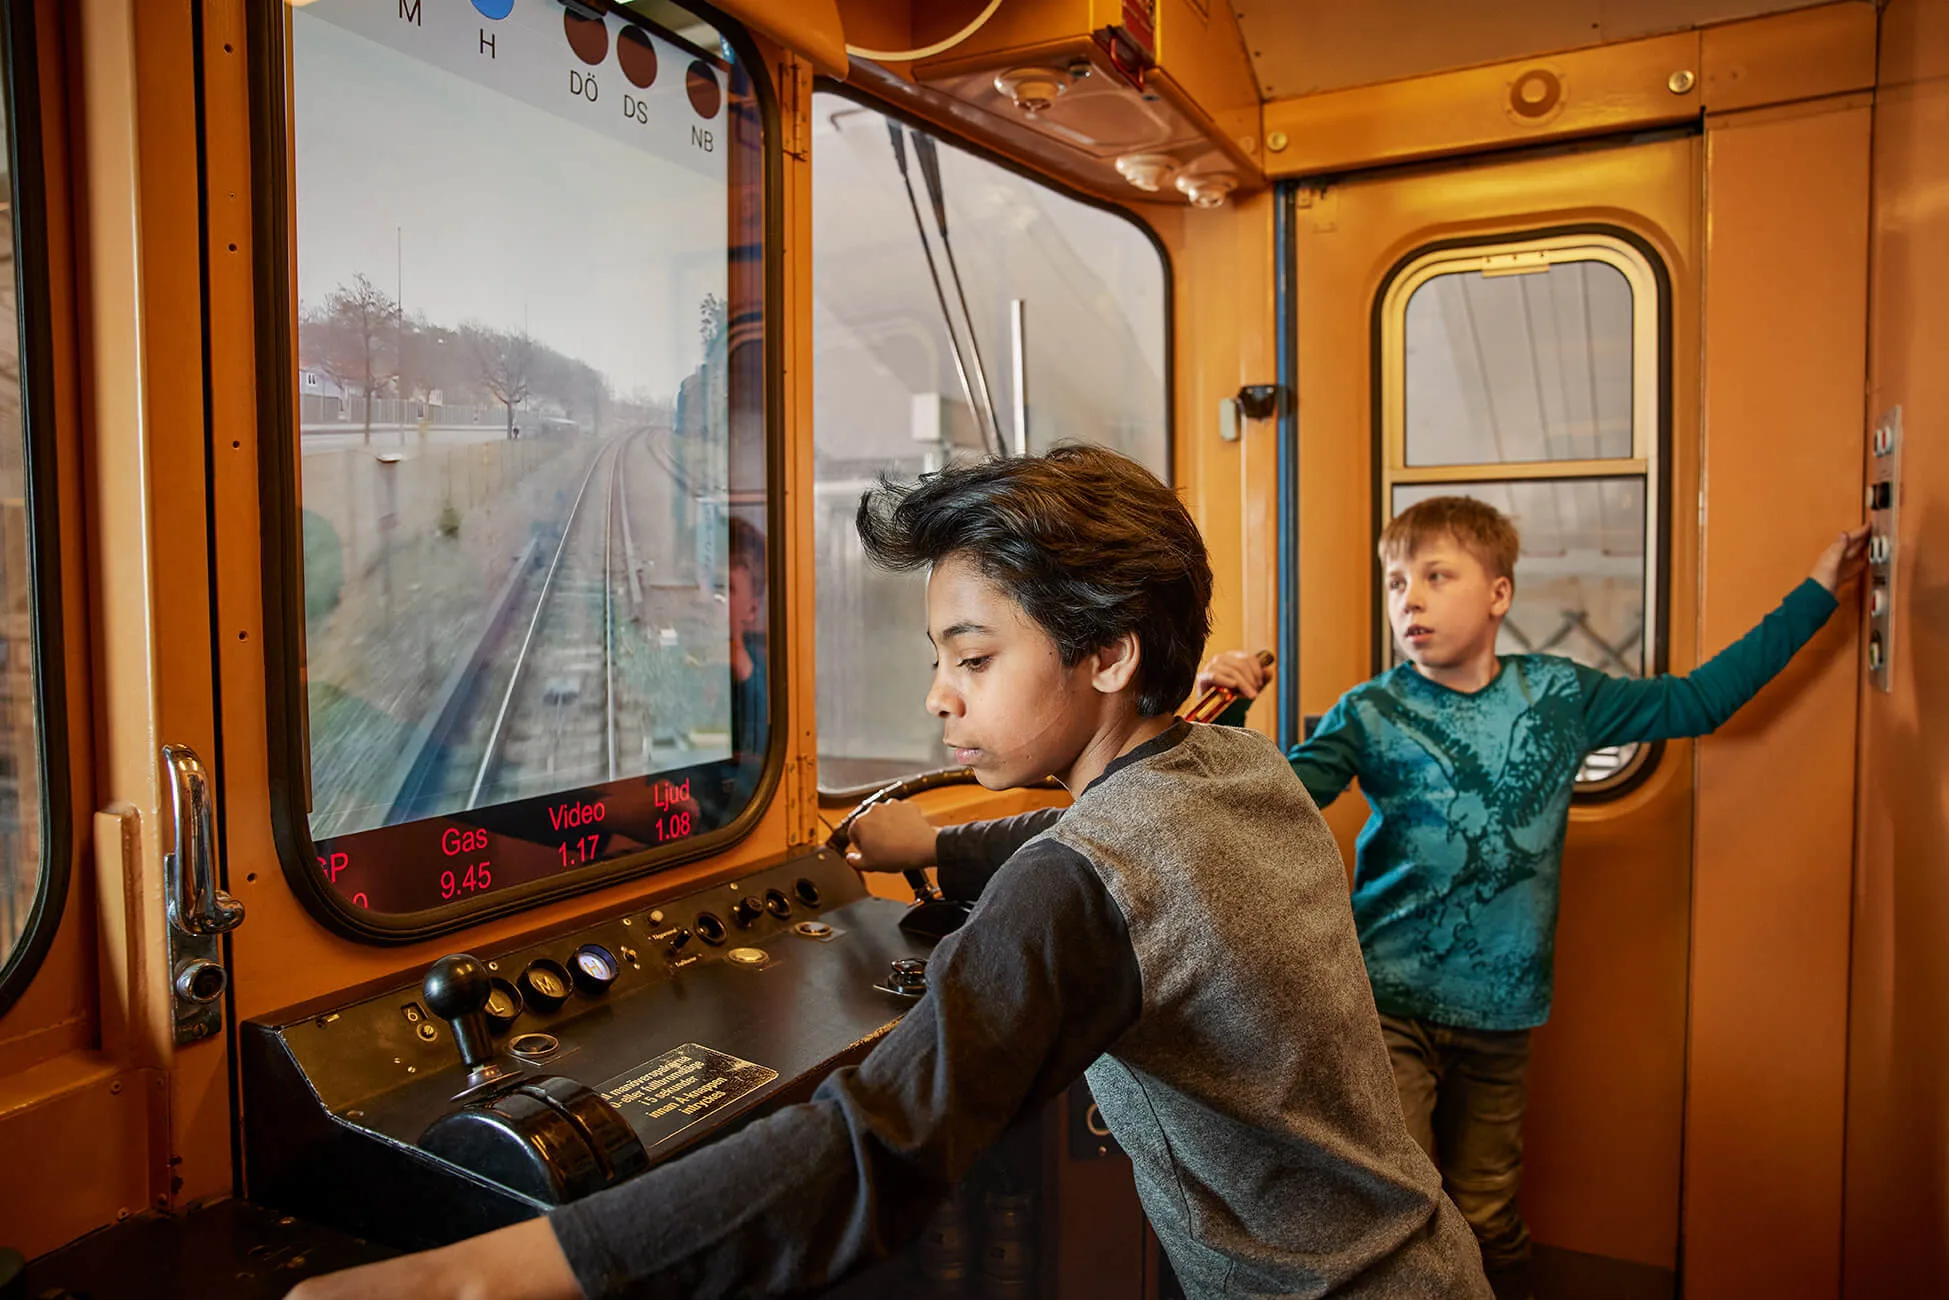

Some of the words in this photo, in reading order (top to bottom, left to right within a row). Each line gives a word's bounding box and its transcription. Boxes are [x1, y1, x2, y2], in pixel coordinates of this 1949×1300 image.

[398, 0, 422, 27] M
[478, 29, 497, 59] H
[569, 69, 599, 102] DÖ
[623, 94, 649, 125] DS
[691, 125, 715, 153] NB
[654, 778, 691, 810] Ljud
[548, 801, 606, 833] Video
[655, 812, 692, 842] 1.08
[441, 827, 488, 856] Gas
[558, 834, 601, 867] 1.17
[440, 861, 493, 899] 9.45
[583, 959, 604, 977] H
[534, 976, 556, 995] M
[407, 1009, 419, 1023] 6
[644, 1095, 658, 1104] 5
[655, 1075, 699, 1100] sekunder
[677, 1089, 728, 1116] intryckes
[645, 1101, 681, 1119] innan
